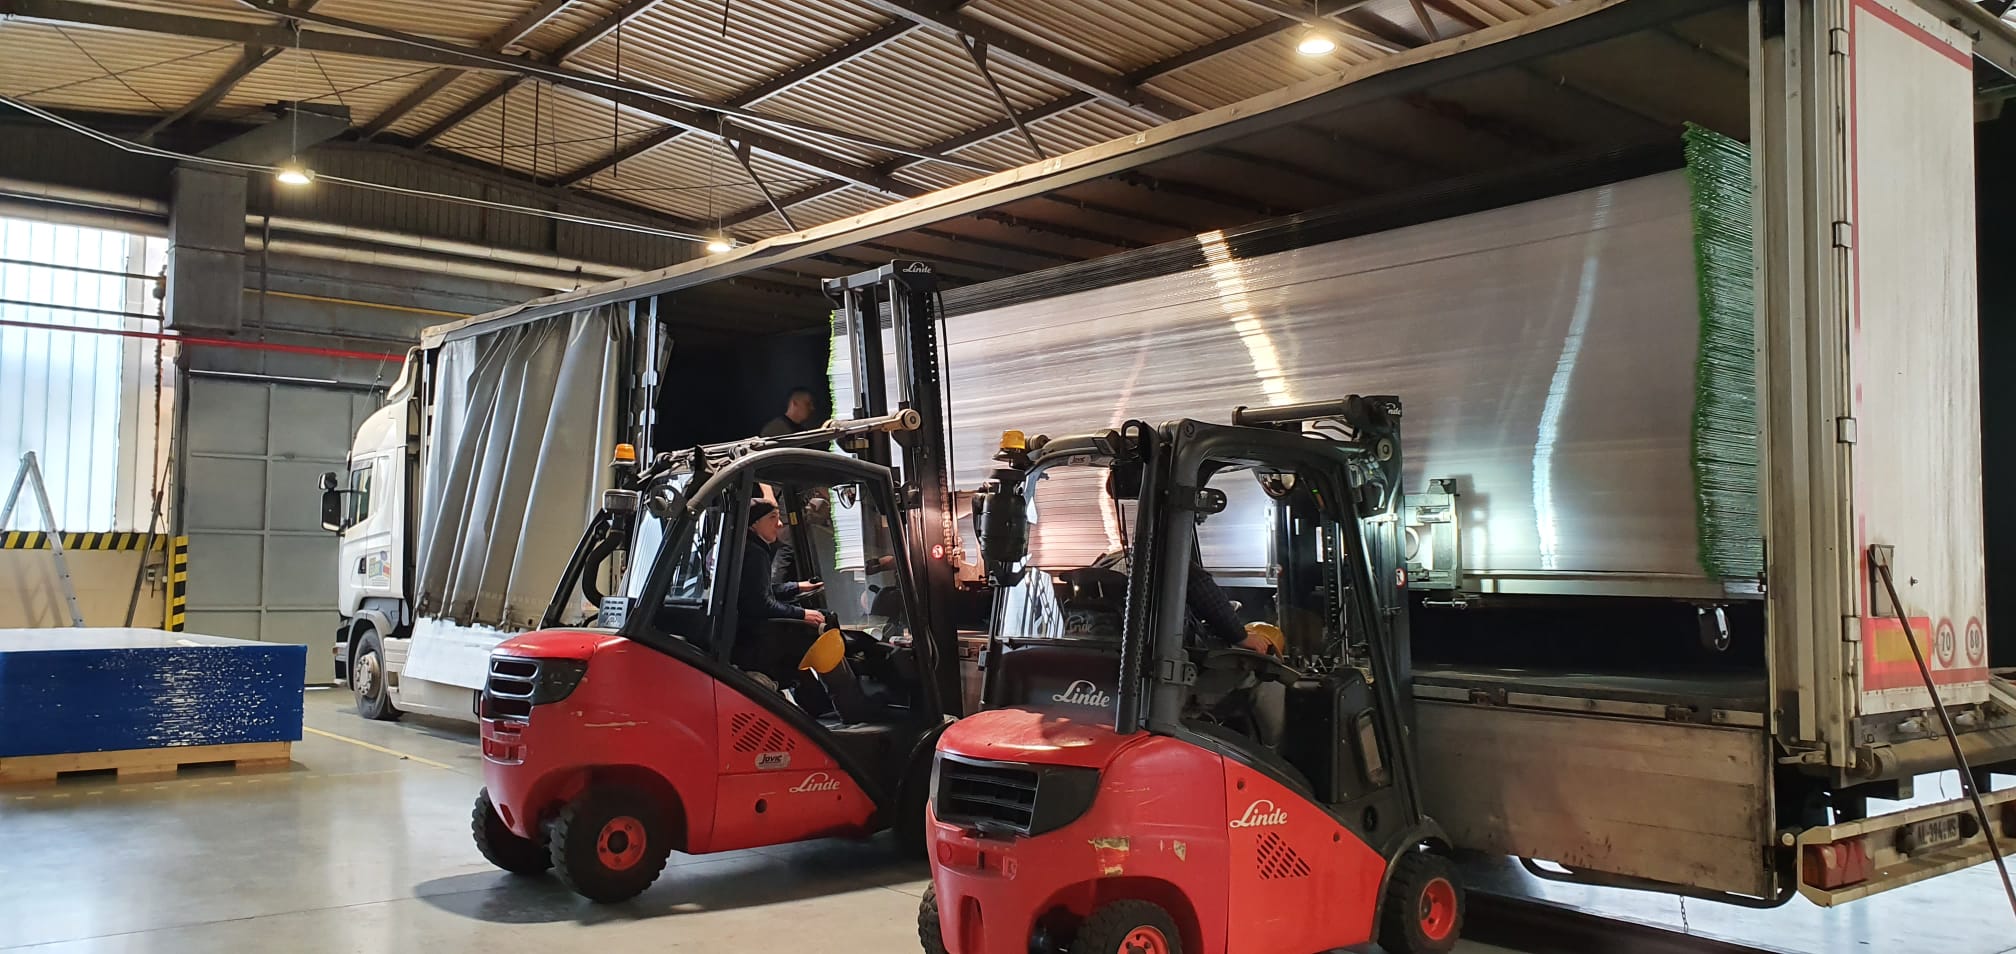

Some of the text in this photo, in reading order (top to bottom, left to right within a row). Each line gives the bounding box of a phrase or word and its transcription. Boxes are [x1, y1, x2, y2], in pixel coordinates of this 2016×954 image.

[1941, 631, 1952, 652] 70
[1970, 630, 1980, 649] 80
[1052, 680, 1110, 707] Linde
[789, 772, 841, 793] Linde
[1229, 799, 1288, 828] Linde
